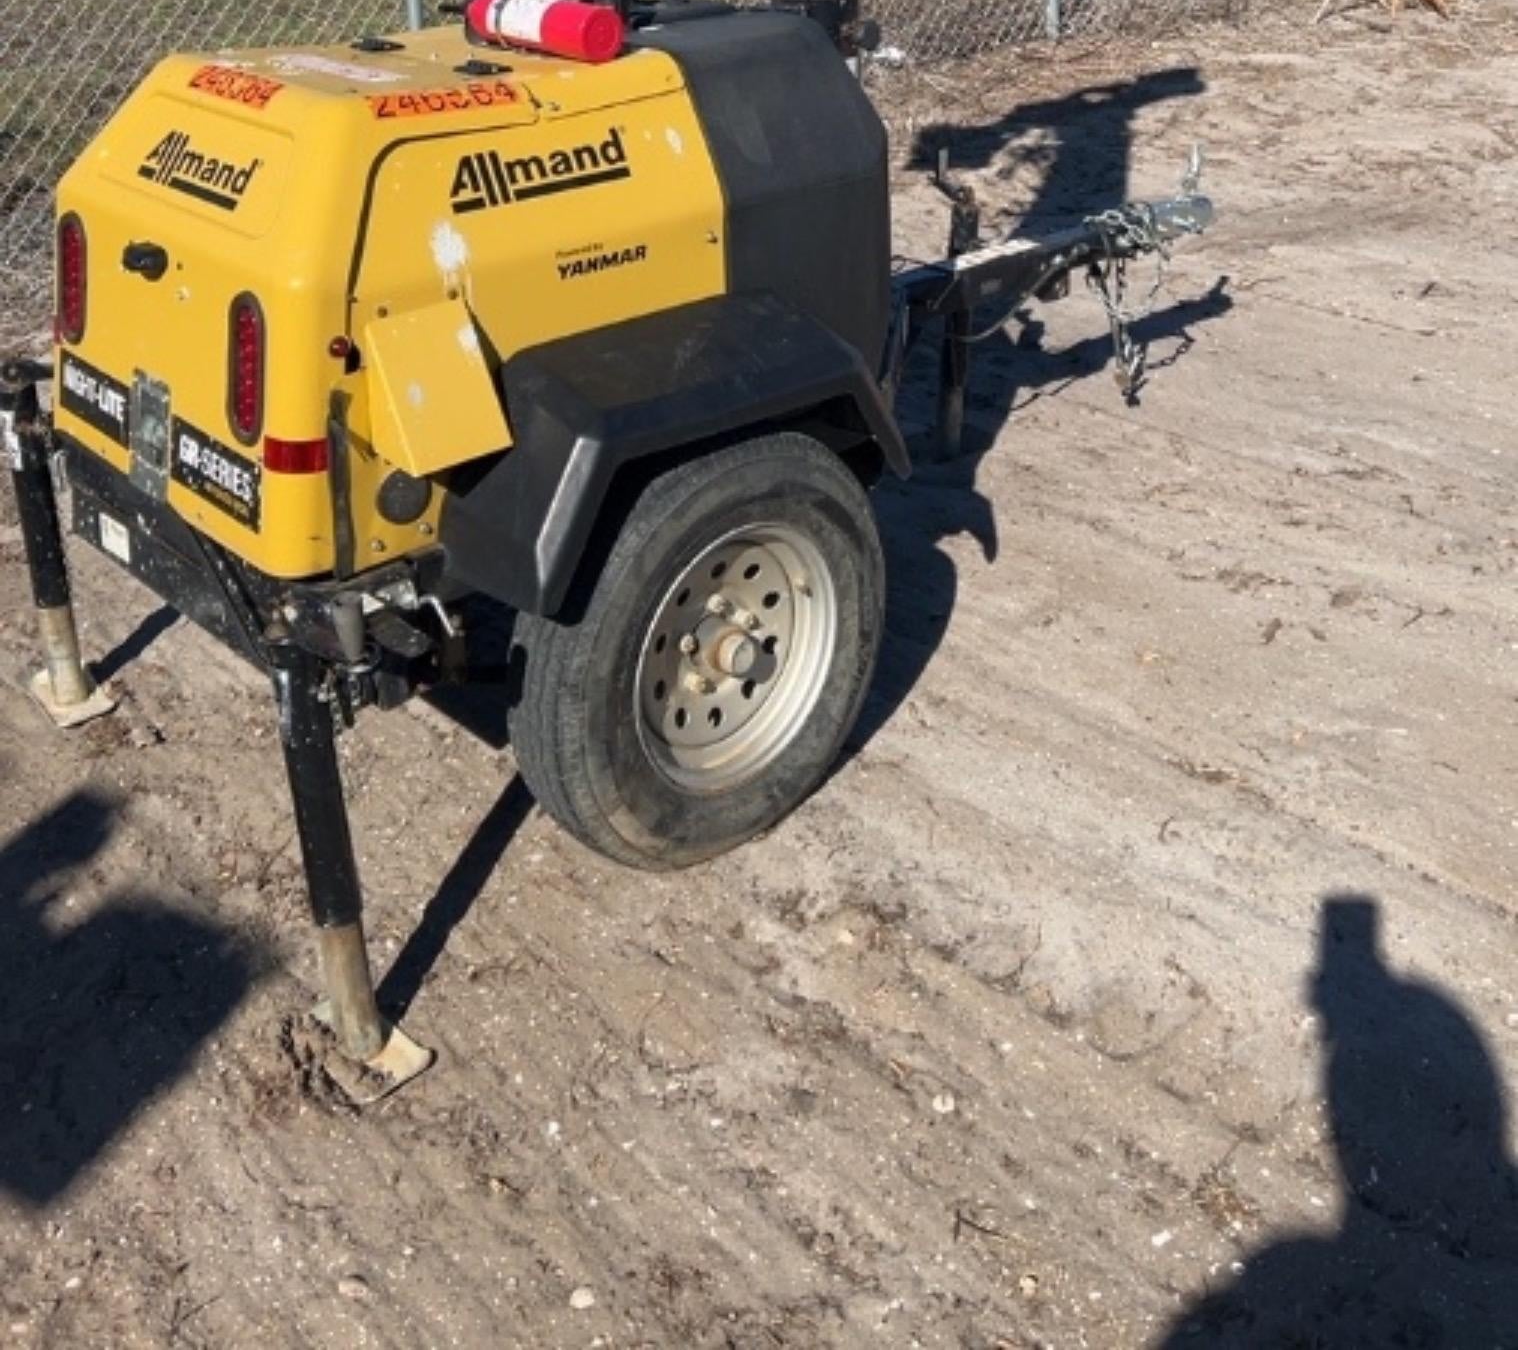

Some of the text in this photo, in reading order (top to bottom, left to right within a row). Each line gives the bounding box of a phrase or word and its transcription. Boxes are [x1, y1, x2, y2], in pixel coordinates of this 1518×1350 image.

[144, 129, 260, 197] Allmand
[450, 125, 627, 208] Allmand
[557, 244, 647, 281] YANMAR
